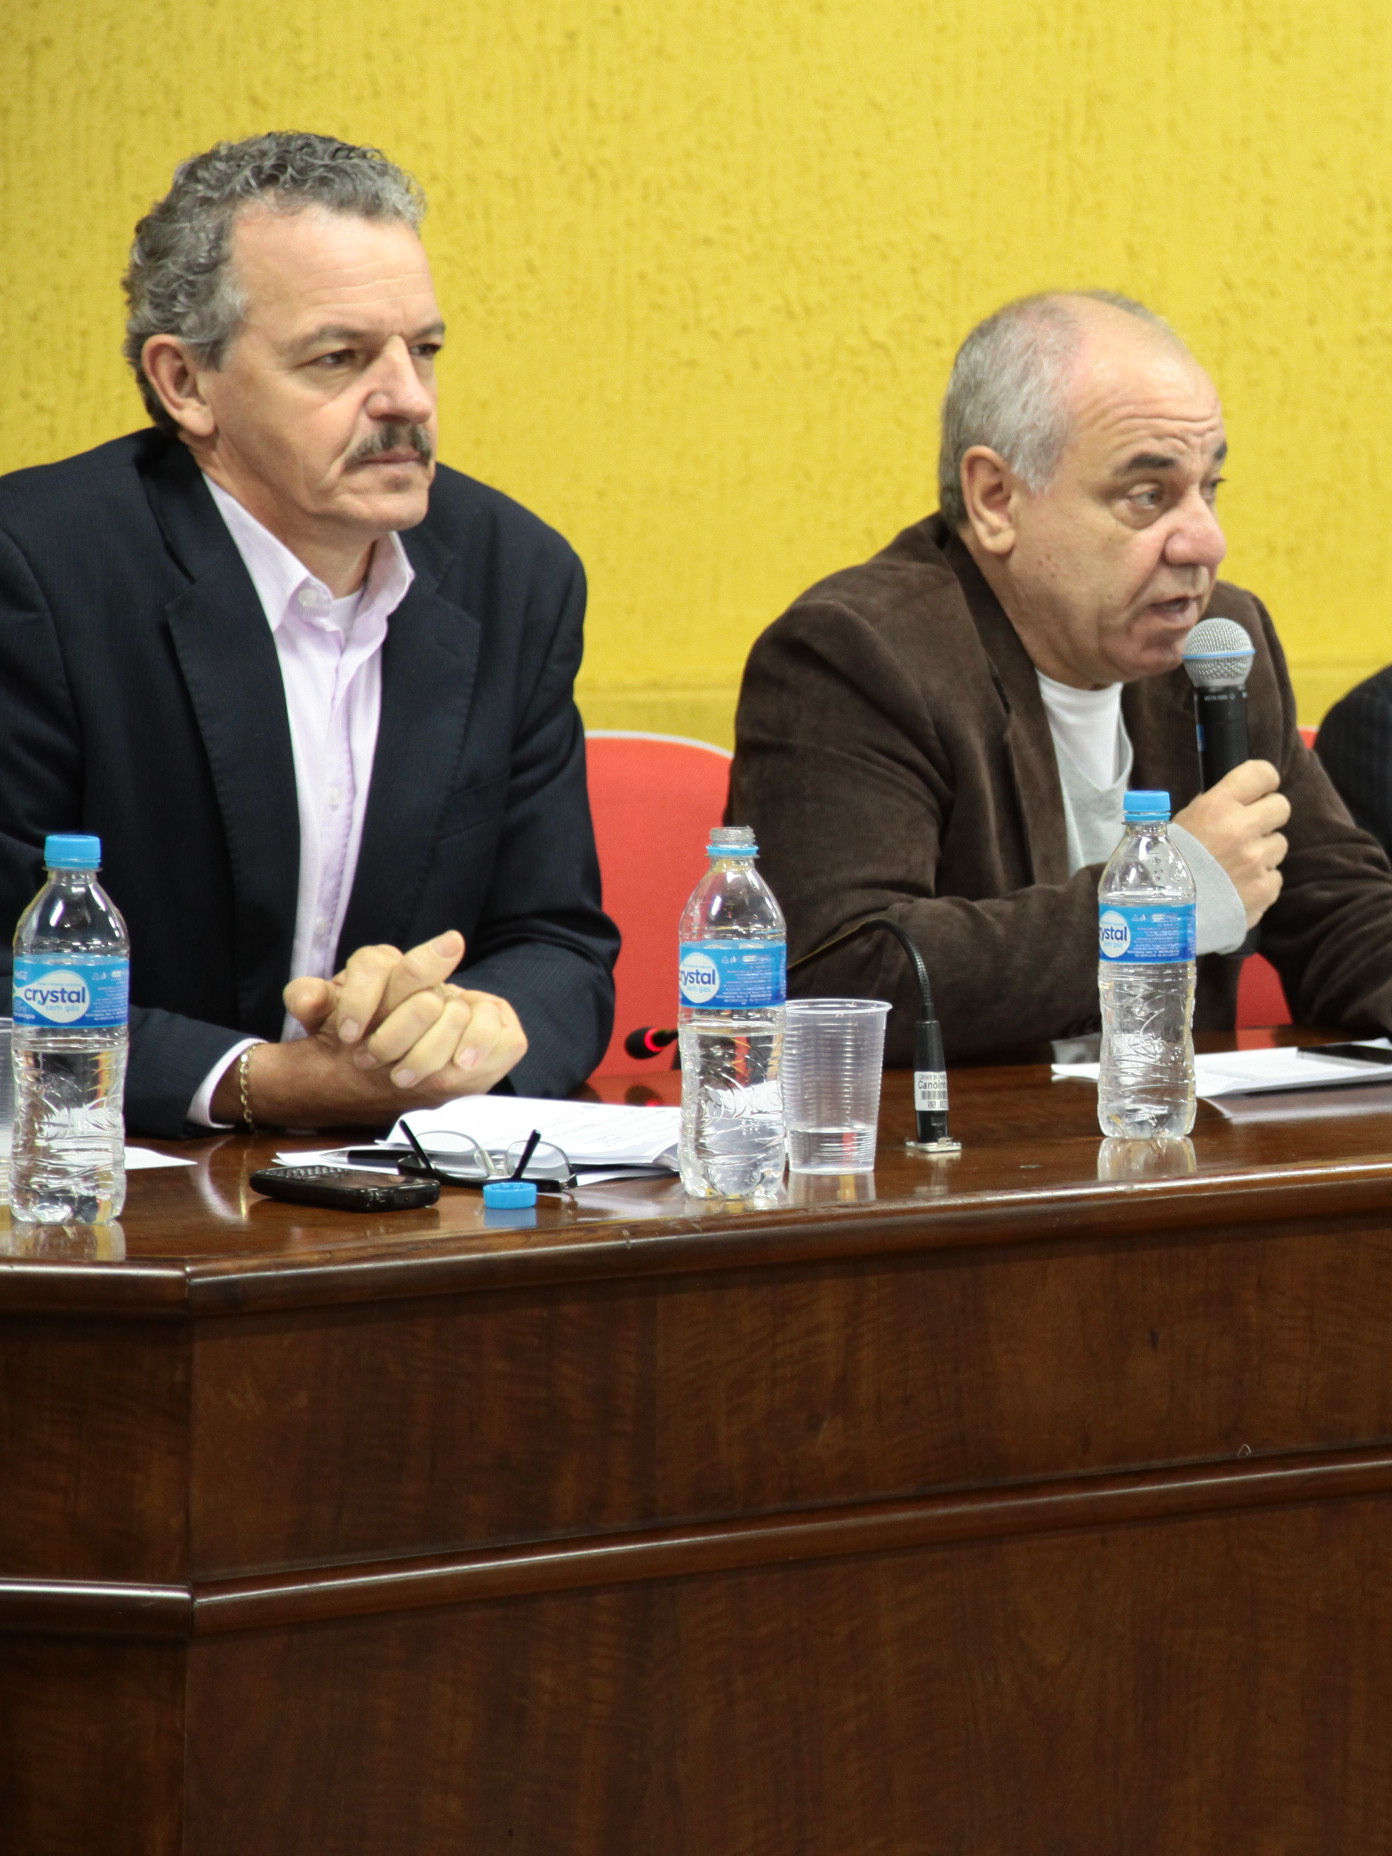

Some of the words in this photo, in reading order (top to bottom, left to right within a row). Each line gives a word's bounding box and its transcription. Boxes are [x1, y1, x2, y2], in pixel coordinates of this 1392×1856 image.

[1099, 926, 1127, 941] ystal
[679, 969, 715, 986] rystal
[24, 986, 86, 1005] crystal
